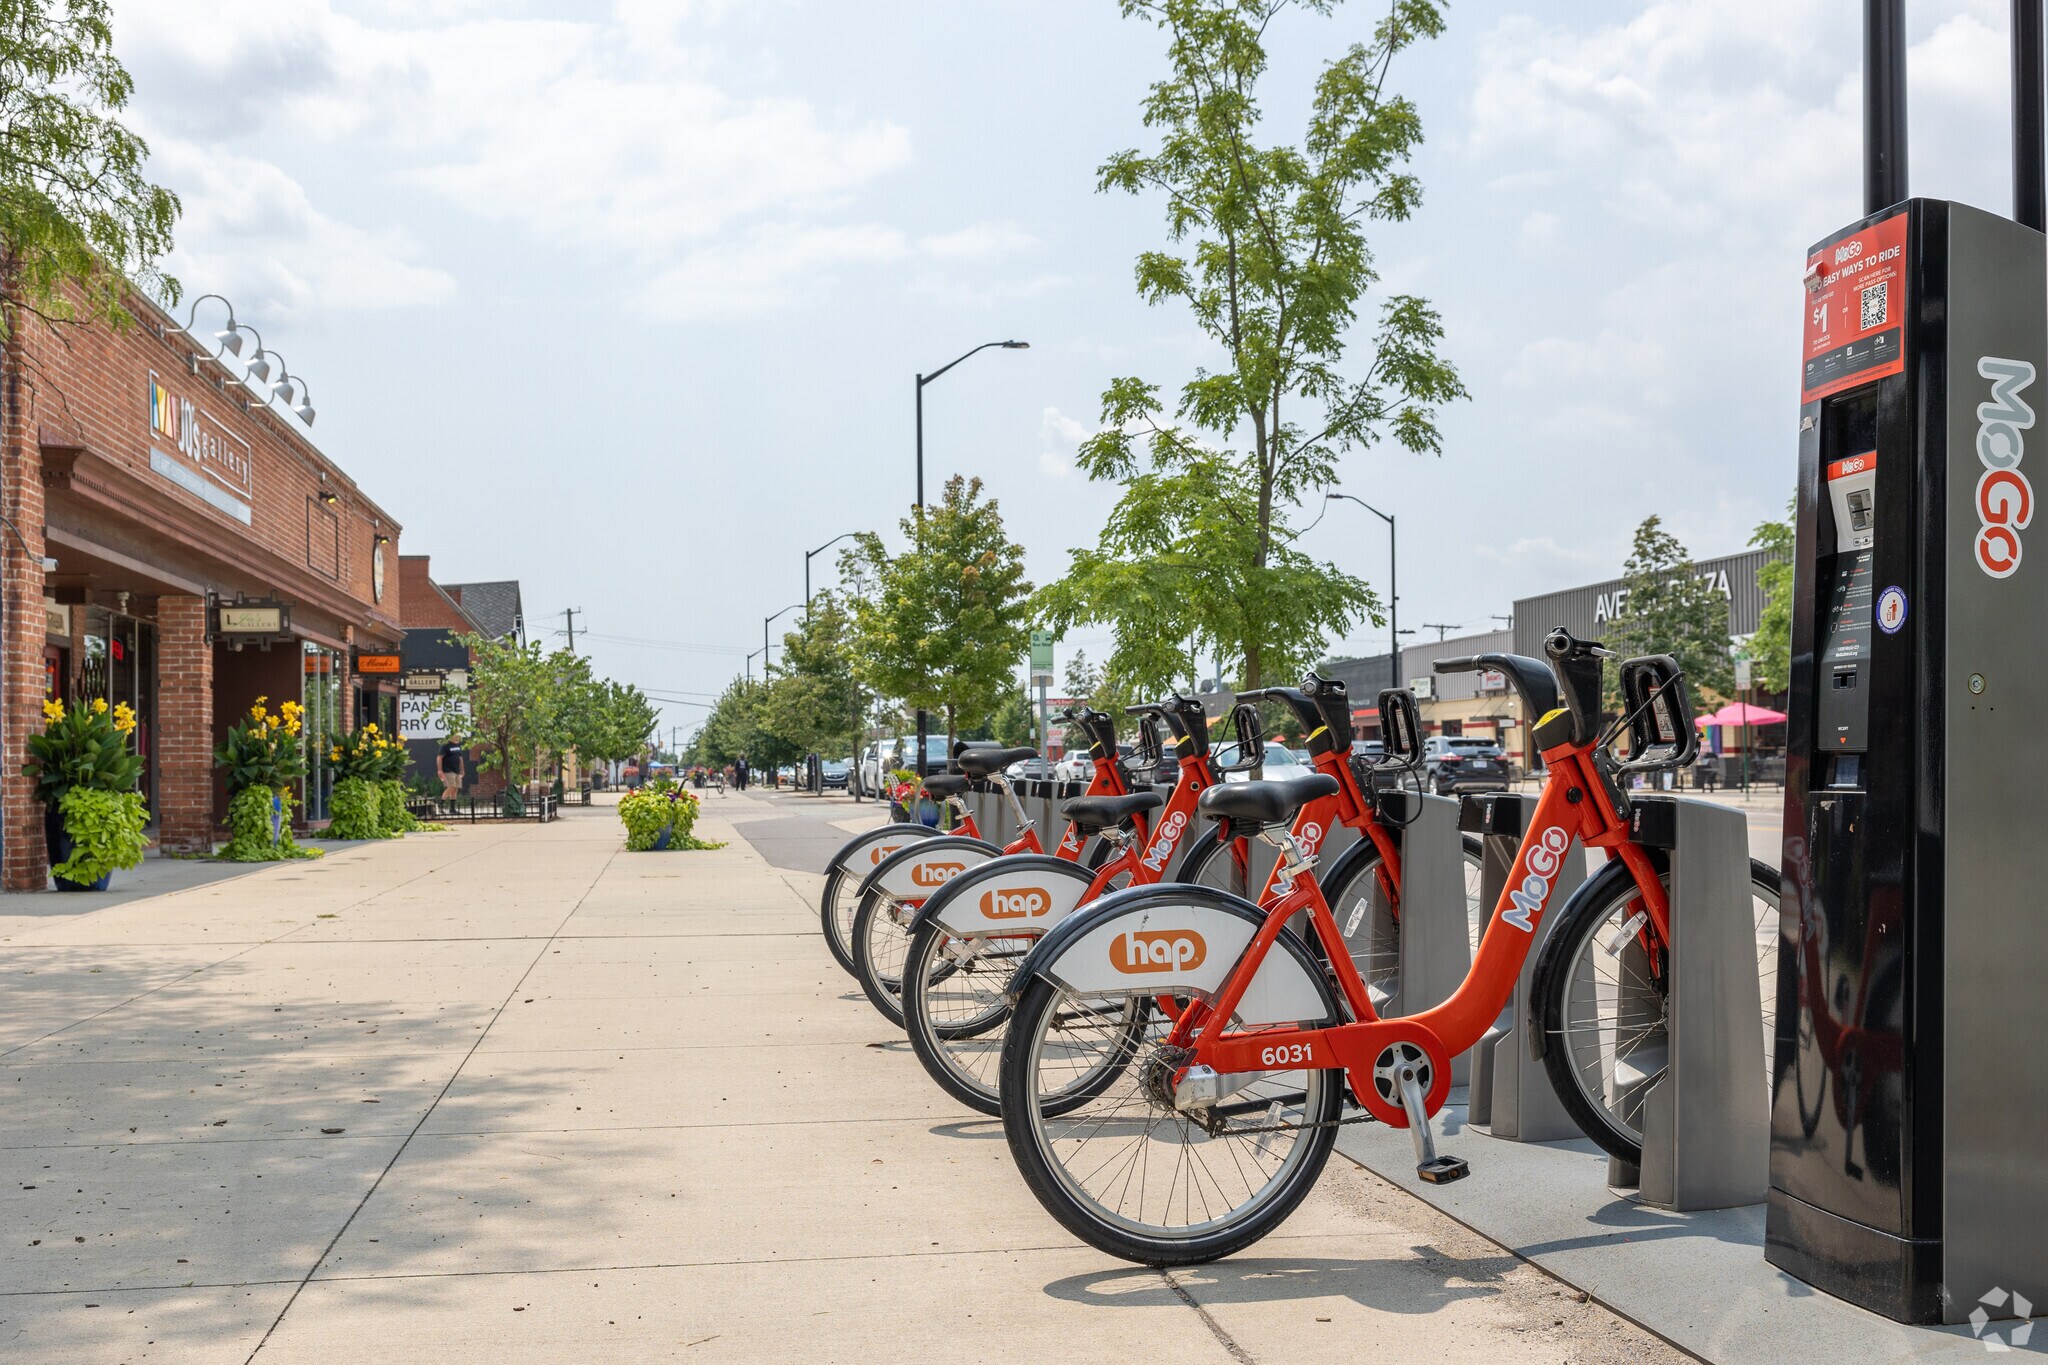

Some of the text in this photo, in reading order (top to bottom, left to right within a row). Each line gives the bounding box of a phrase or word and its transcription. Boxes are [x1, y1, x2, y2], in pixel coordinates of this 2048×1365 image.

[1823, 270, 1840, 287] EASY
[1842, 260, 1863, 278] WAYS
[1865, 255, 1877, 267] TO
[1879, 245, 1900, 263] RIDE
[1813, 303, 1828, 333] $1
[202, 432, 248, 485] gallery
[991, 888, 1043, 918] hap
[1125, 929, 1196, 972] hap
[1261, 1043, 1313, 1066] 6031
